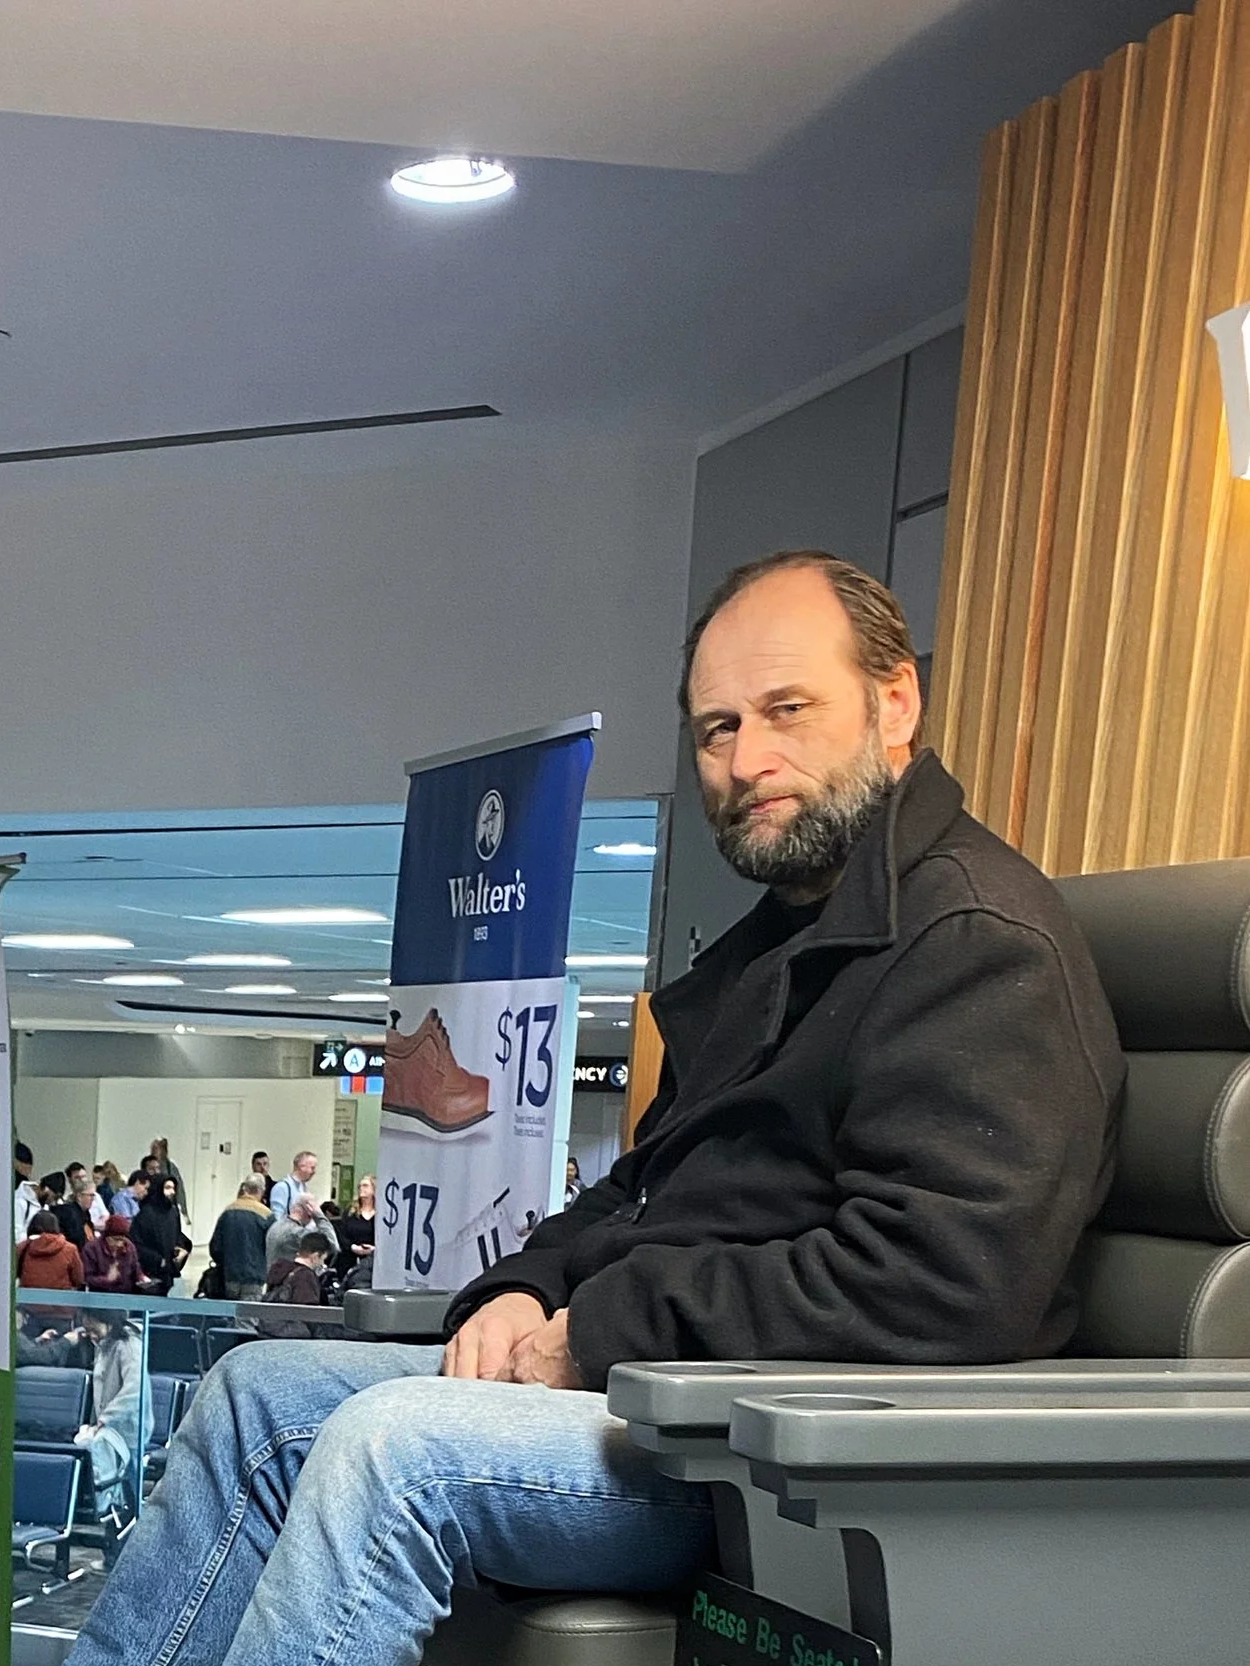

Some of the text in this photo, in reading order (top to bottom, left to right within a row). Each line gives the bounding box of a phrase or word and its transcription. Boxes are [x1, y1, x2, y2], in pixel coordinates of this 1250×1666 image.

[448, 868, 526, 918] Walter's
[349, 1053, 360, 1067] A
[495, 1004, 558, 1108] $13
[572, 1067, 607, 1082] NCY
[382, 1177, 440, 1277] $13
[692, 1589, 747, 1645] Please
[755, 1617, 781, 1660] Be
